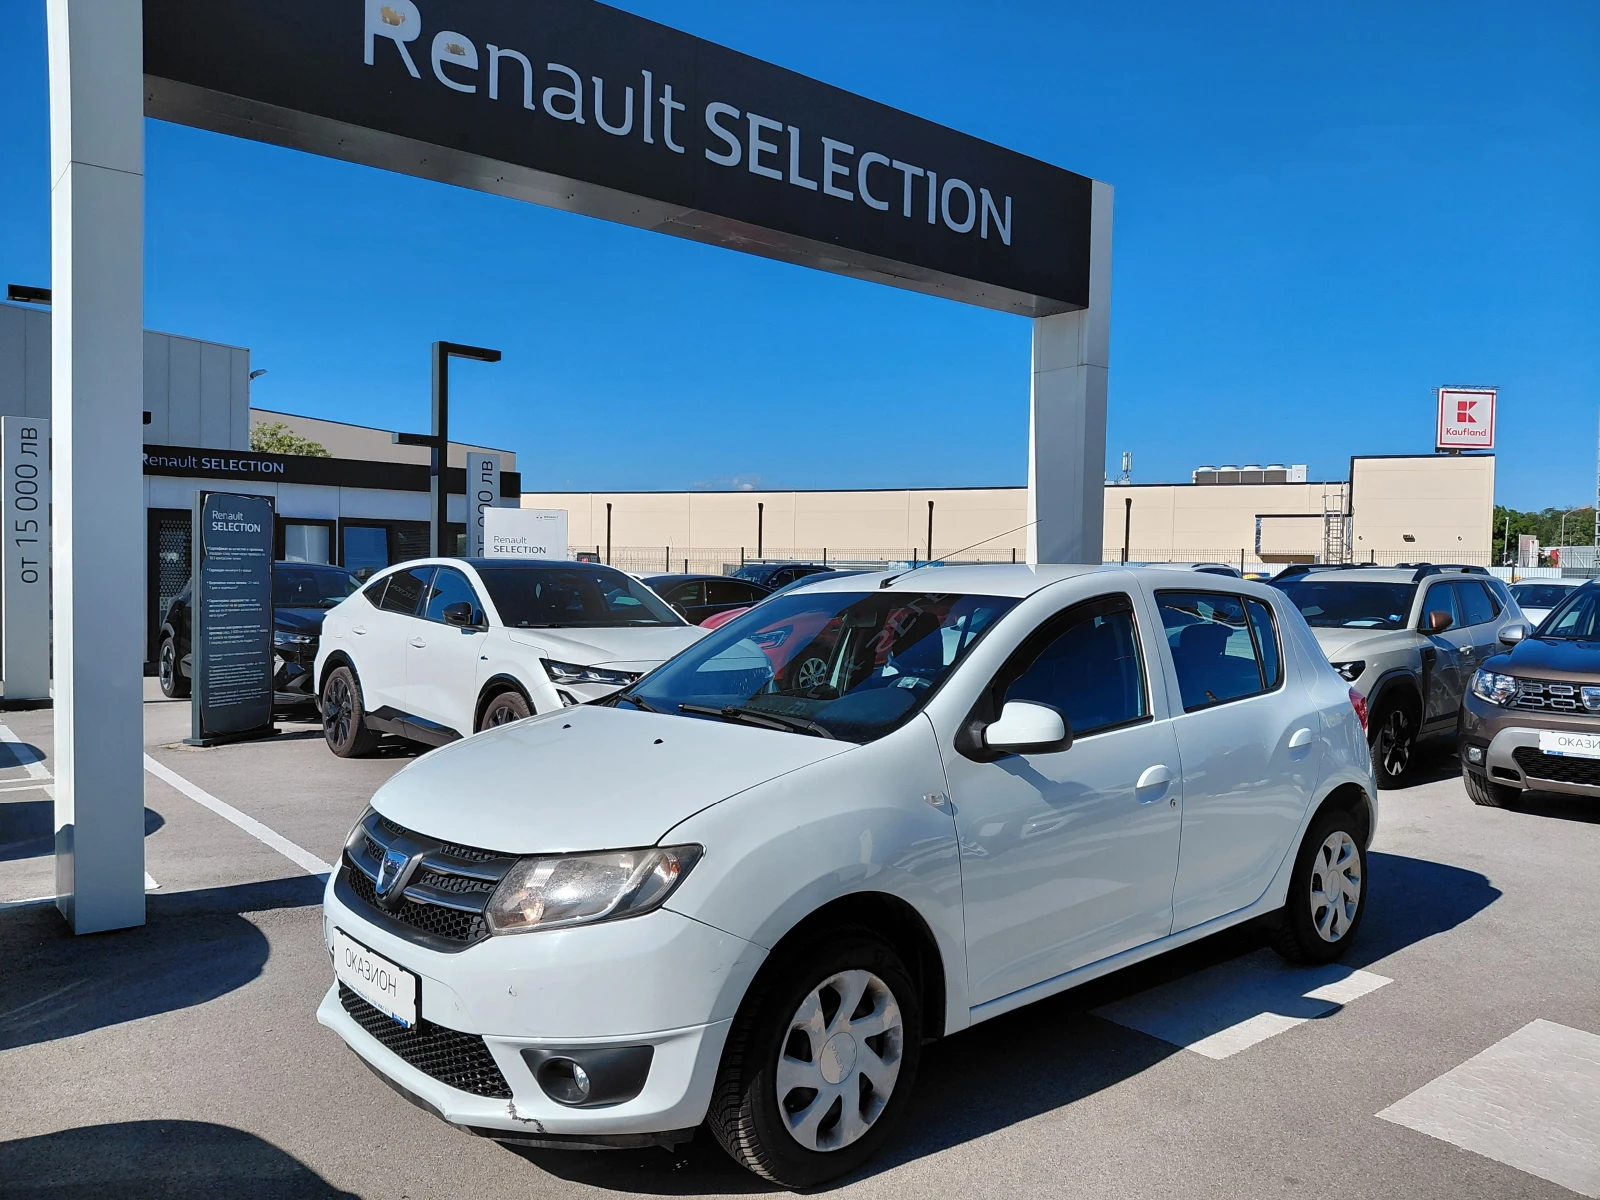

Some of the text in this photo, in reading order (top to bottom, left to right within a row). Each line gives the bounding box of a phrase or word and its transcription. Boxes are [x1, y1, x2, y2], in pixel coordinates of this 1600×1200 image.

[363, 0, 1012, 246] Renault SELECTION
[1446, 427, 1487, 437] Kaufland
[201, 457, 284, 474] SELECTION
[14, 464, 39, 511] 000
[211, 510, 244, 521] Renault
[15, 519, 39, 548] 15
[211, 521, 261, 533] SELECTION
[493, 535, 528, 545] Renault
[493, 545, 547, 554] SELECTION
[345, 947, 397, 998] ОКАЗИОН
